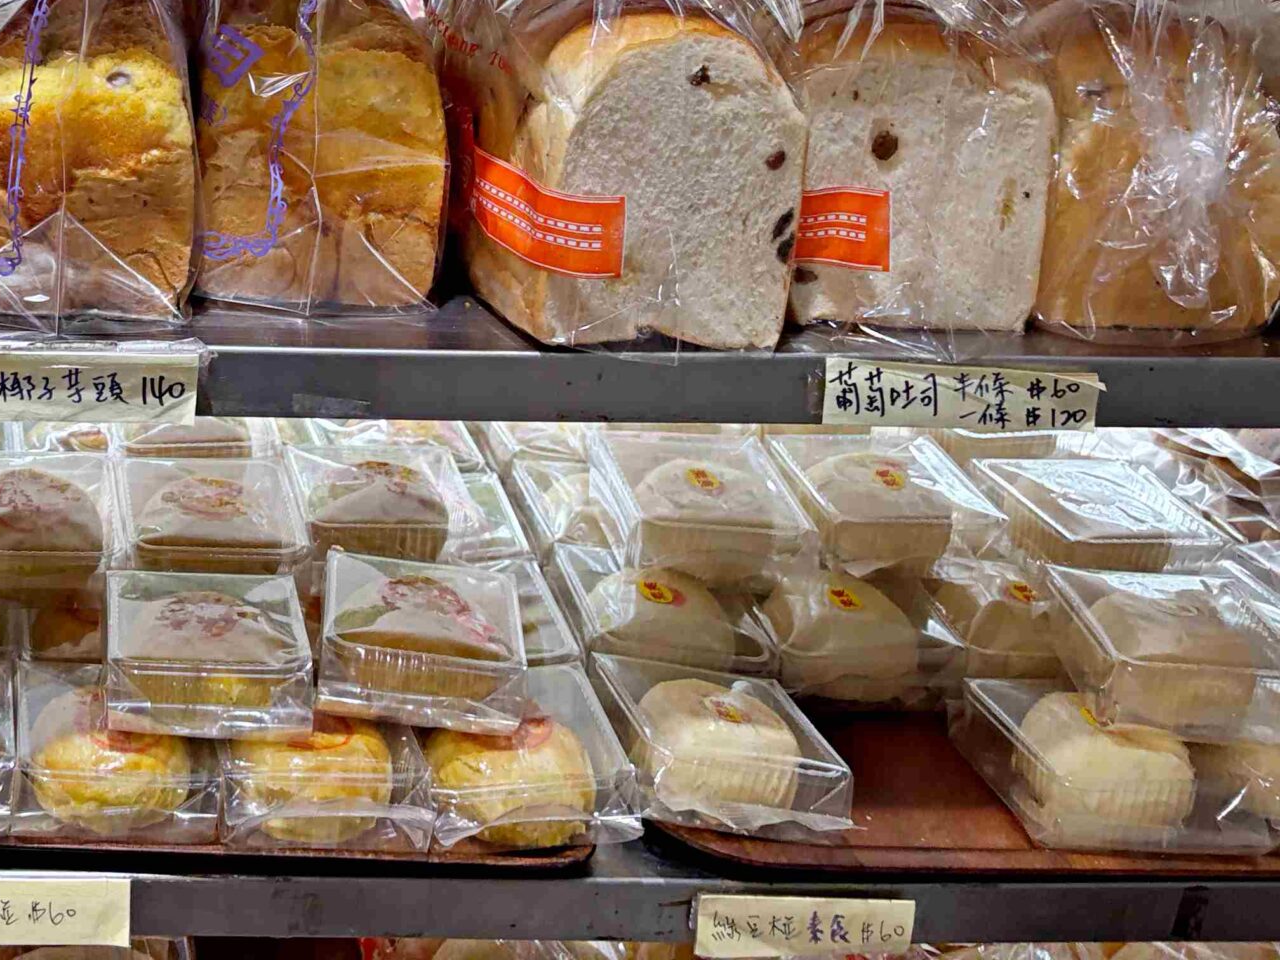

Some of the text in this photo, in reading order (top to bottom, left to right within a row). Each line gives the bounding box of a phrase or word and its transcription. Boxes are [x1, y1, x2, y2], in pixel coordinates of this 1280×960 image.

[141, 375, 186, 406] 140
[829, 361, 1081, 417] 葡萄吐司 半條 $60
[959, 401, 1087, 429] 一條 $120
[27, 900, 77, 926] $60
[861, 920, 906, 944] $60
